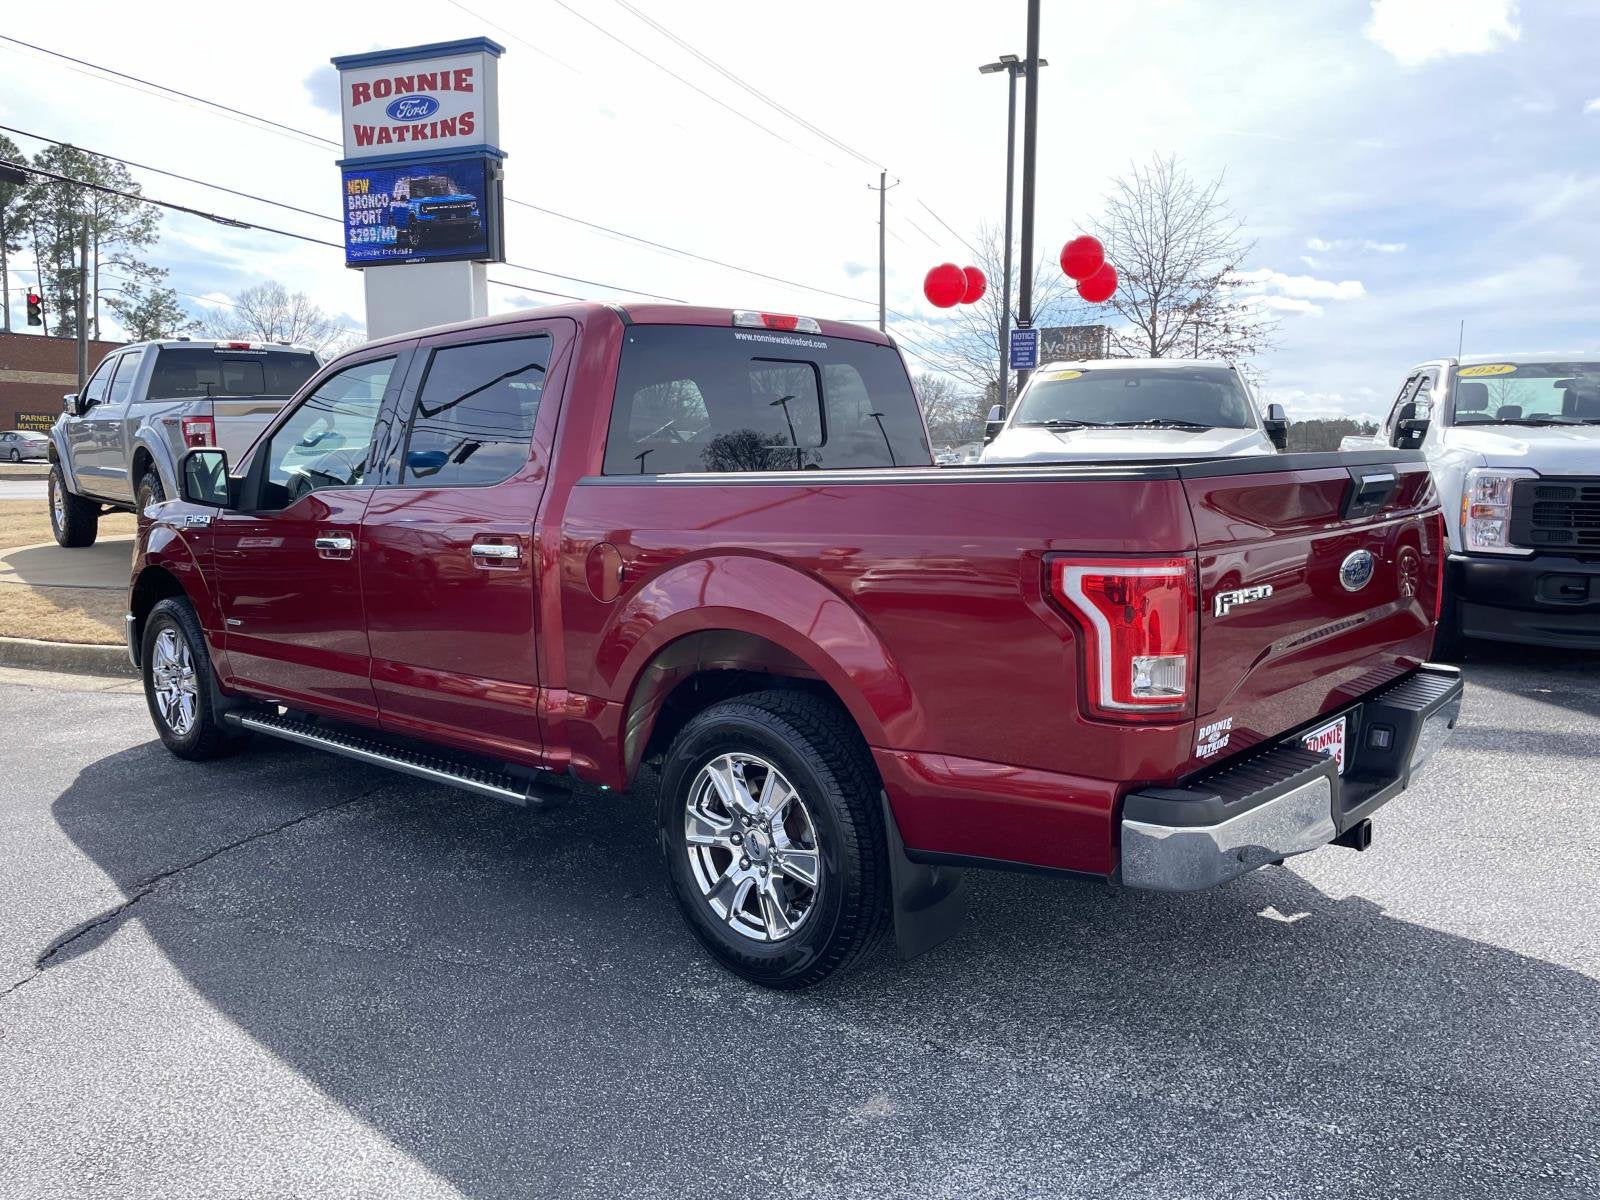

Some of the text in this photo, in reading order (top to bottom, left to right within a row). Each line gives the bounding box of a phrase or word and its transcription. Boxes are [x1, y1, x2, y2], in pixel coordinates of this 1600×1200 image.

[352, 68, 473, 107] RONNIE
[397, 99, 429, 118] Ford
[353, 111, 474, 147] WATKINS
[347, 179, 369, 194] NEW
[348, 193, 389, 210] BRONCO
[349, 209, 383, 226] SPORT
[734, 332, 828, 349] www.ronniewatkinsford.com
[1013, 332, 1035, 340] NOTICE
[1198, 716, 1233, 741] RONNIE
[1196, 733, 1230, 758] WATKINS
